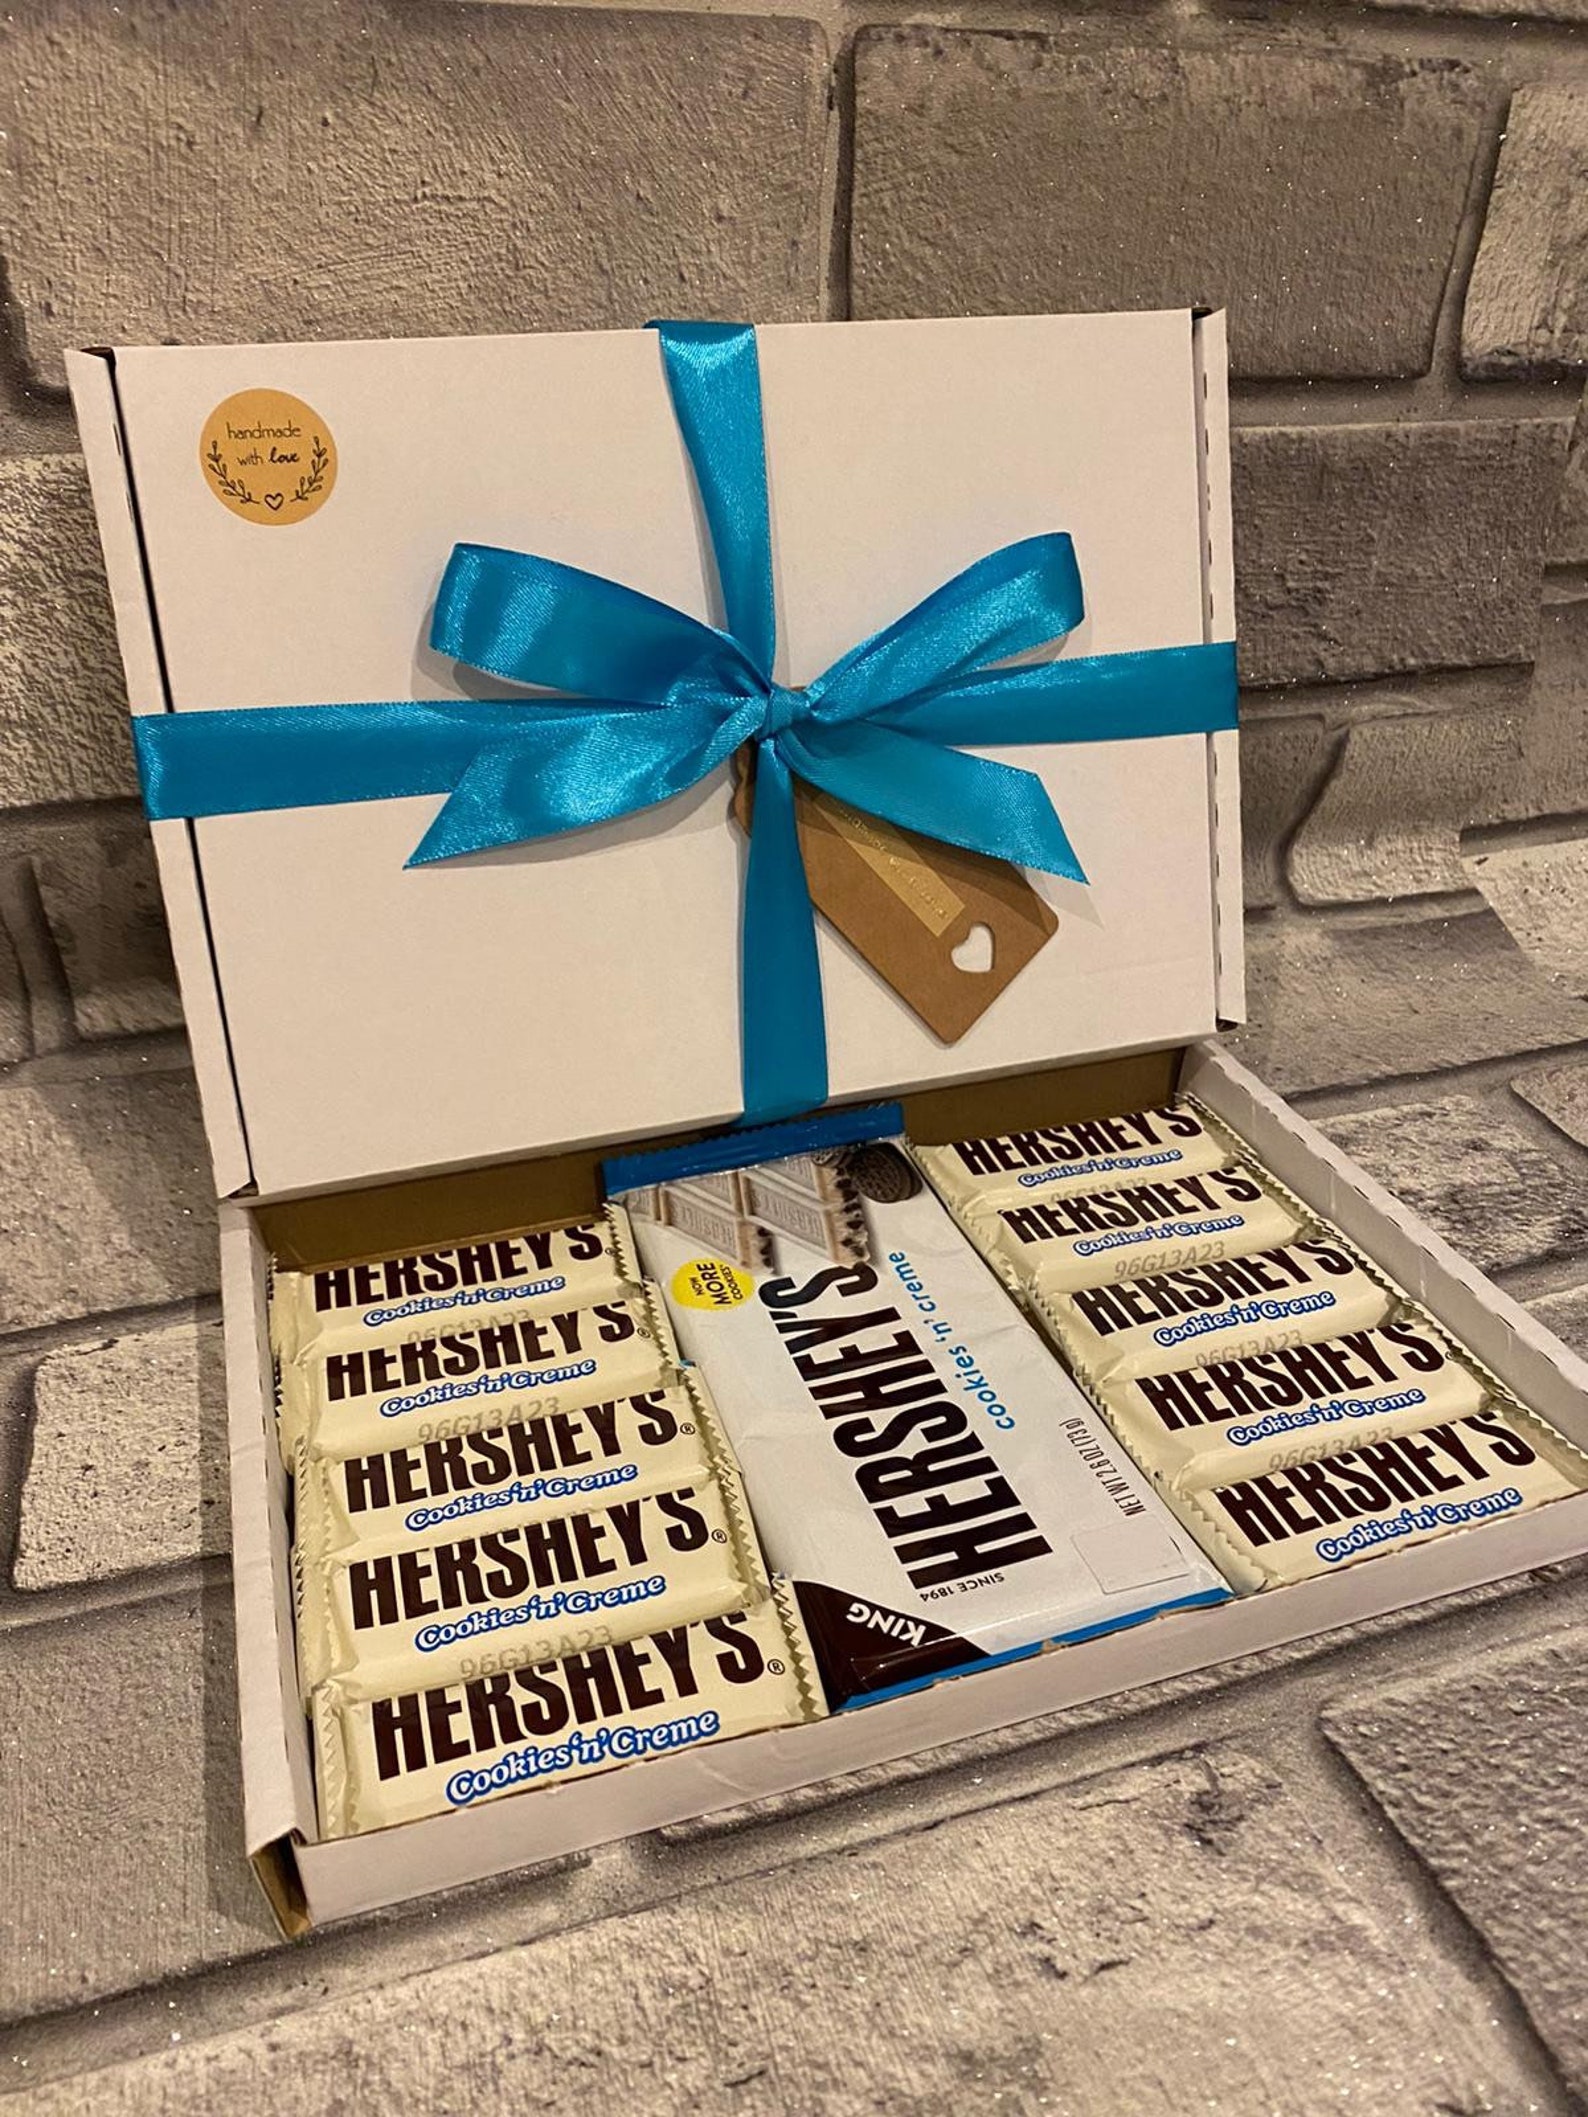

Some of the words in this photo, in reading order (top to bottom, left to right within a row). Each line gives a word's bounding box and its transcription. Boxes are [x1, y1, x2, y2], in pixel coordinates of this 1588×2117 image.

[226, 420, 301, 439] handmade
[237, 448, 263, 466] with
[269, 446, 300, 463] love
[951, 1106, 1203, 1175] HERSHEYS
[997, 1167, 1262, 1244] HERSHEYS
[314, 1223, 603, 1312] HERSHEYS
[888, 1251, 936, 1313] creme
[1114, 1241, 1226, 1280] 96G13A23
[688, 1277, 705, 1296] NOW
[696, 1262, 732, 1305] MORE
[1071, 1239, 1355, 1336] HERSHEYS
[327, 1300, 635, 1401] HERSHEYS
[948, 1345, 1015, 1430] cookies
[758, 1261, 1054, 1590] HERSHEY'S
[1079, 1444, 1104, 1461] OZ
[1101, 1476, 1130, 1496] WT
[1114, 1494, 1146, 1516] NET
[919, 1586, 953, 1602] 1894
[957, 1572, 1005, 1593] SINCE
[846, 1602, 926, 1648] KING
